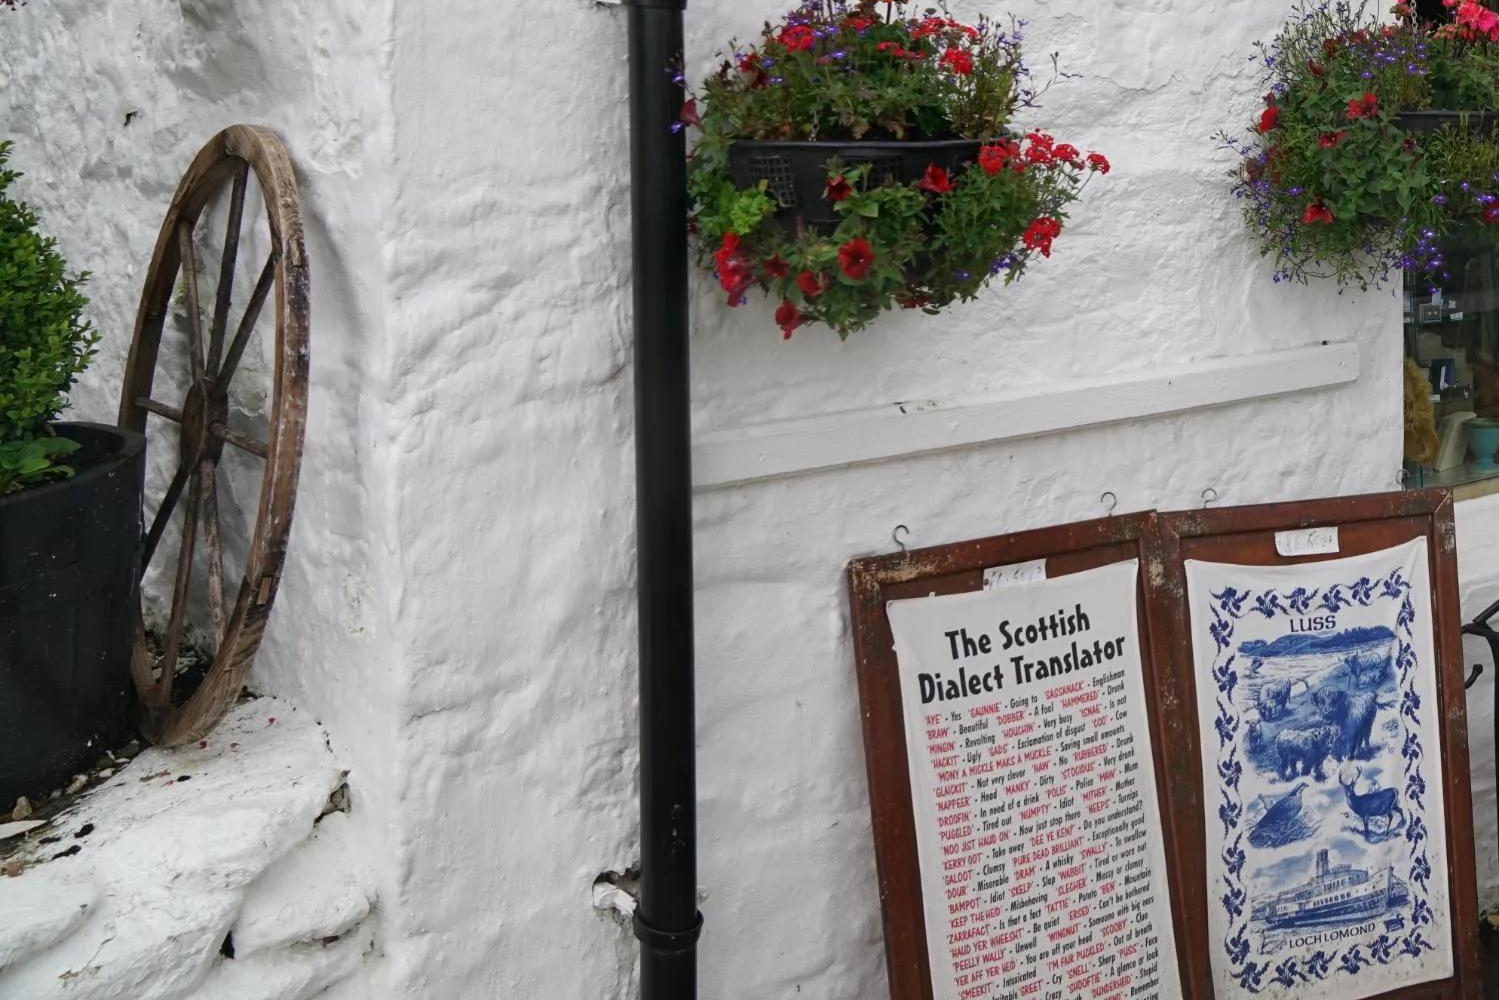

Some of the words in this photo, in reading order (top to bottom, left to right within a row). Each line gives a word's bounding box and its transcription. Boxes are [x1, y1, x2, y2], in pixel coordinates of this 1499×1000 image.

[945, 628, 992, 659] The
[999, 603, 1090, 650] Scottish
[1290, 615, 1336, 632] LUSS
[917, 664, 1003, 704] Dialect
[1010, 636, 1125, 684] Translator
[1289, 934, 1321, 948] LOCH
[1324, 923, 1375, 942] LOMOND
